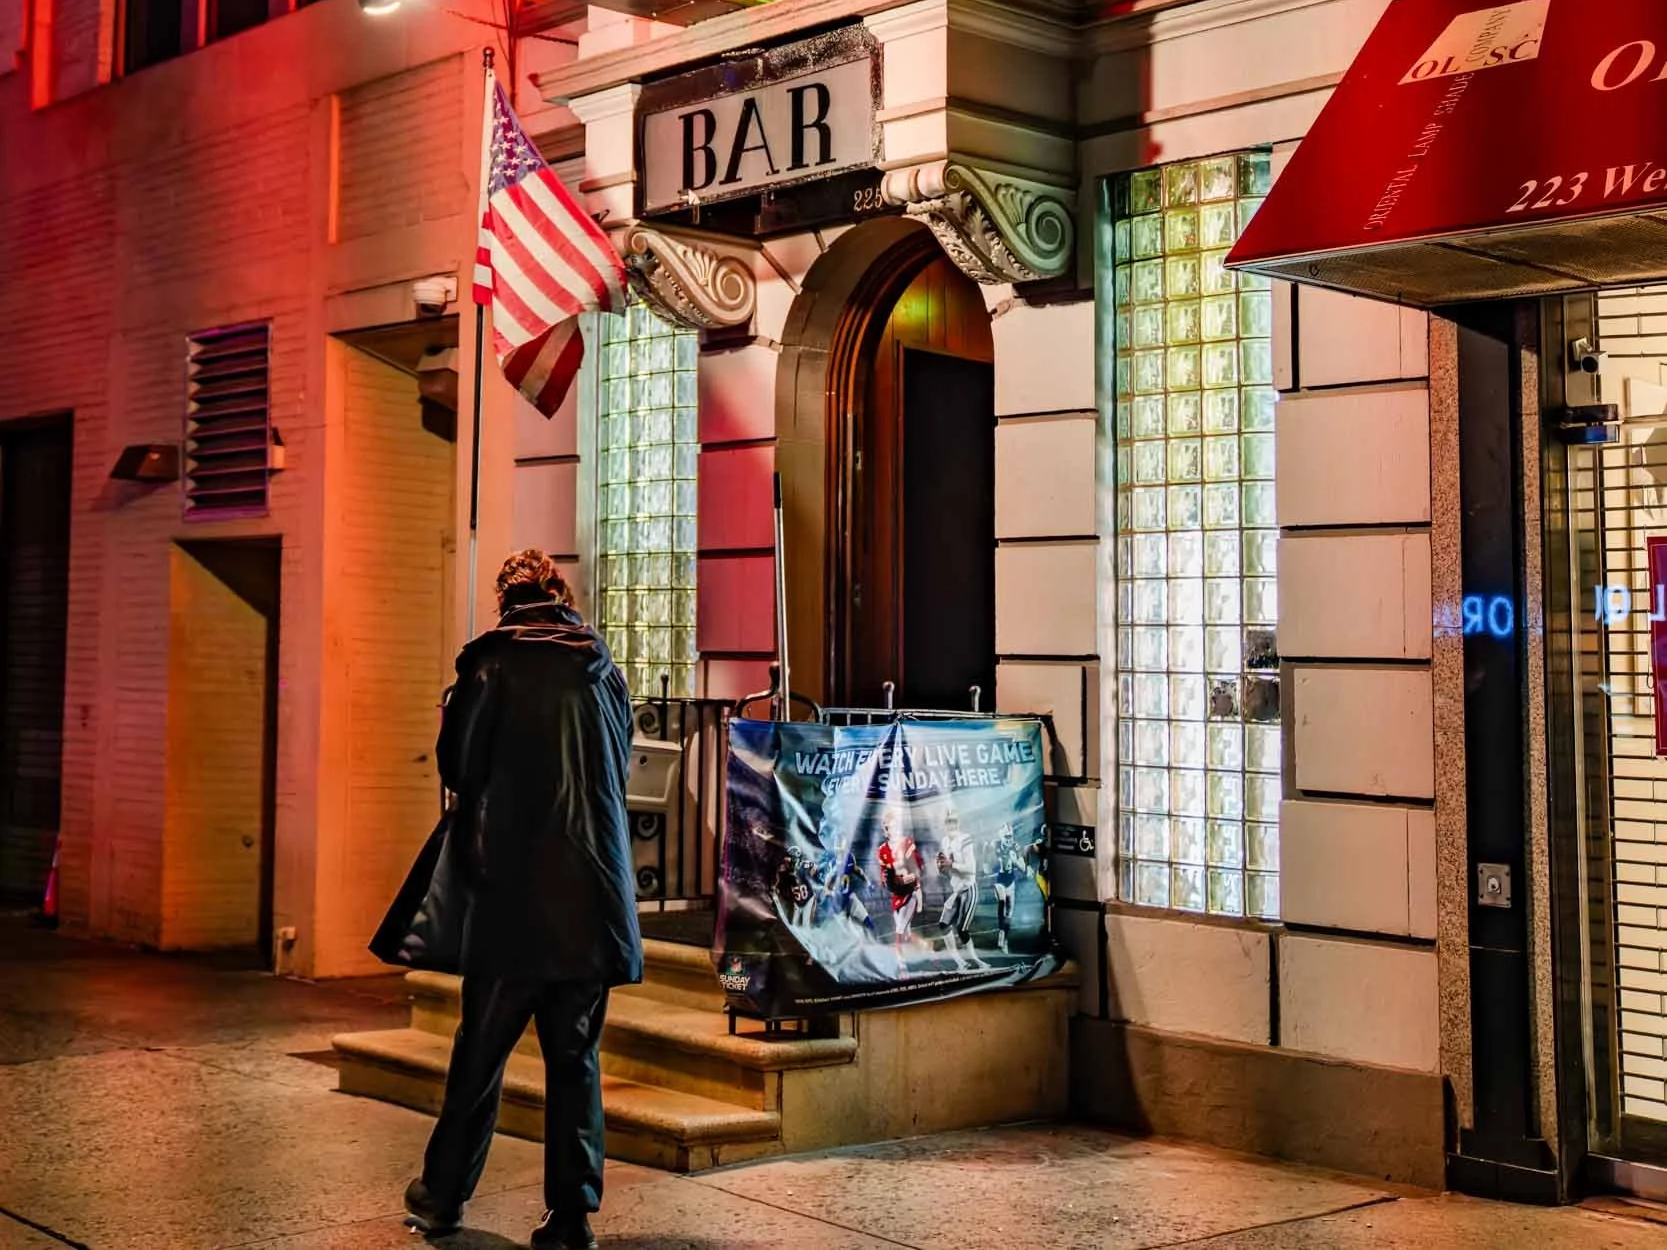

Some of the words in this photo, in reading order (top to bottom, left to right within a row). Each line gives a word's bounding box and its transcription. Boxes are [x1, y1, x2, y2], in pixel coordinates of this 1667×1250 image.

[1363, 164, 1419, 231] ORIENTAL
[1407, 122, 1444, 158] LAMP
[1433, 71, 1475, 117] SHADE
[1465, 8, 1512, 63] COMPANY
[677, 82, 837, 195] BAR
[853, 187, 883, 212] 225
[1505, 171, 1590, 213] 223
[1603, 161, 1667, 199] We
[795, 750, 856, 775] WATCH
[855, 745, 919, 771] EVERY
[924, 743, 972, 767] LIVE
[976, 740, 1035, 764] GAME
[878, 768, 949, 792] SUNDAY
[719, 974, 751, 986] SUNDAY
[721, 982, 747, 991] TICKET
